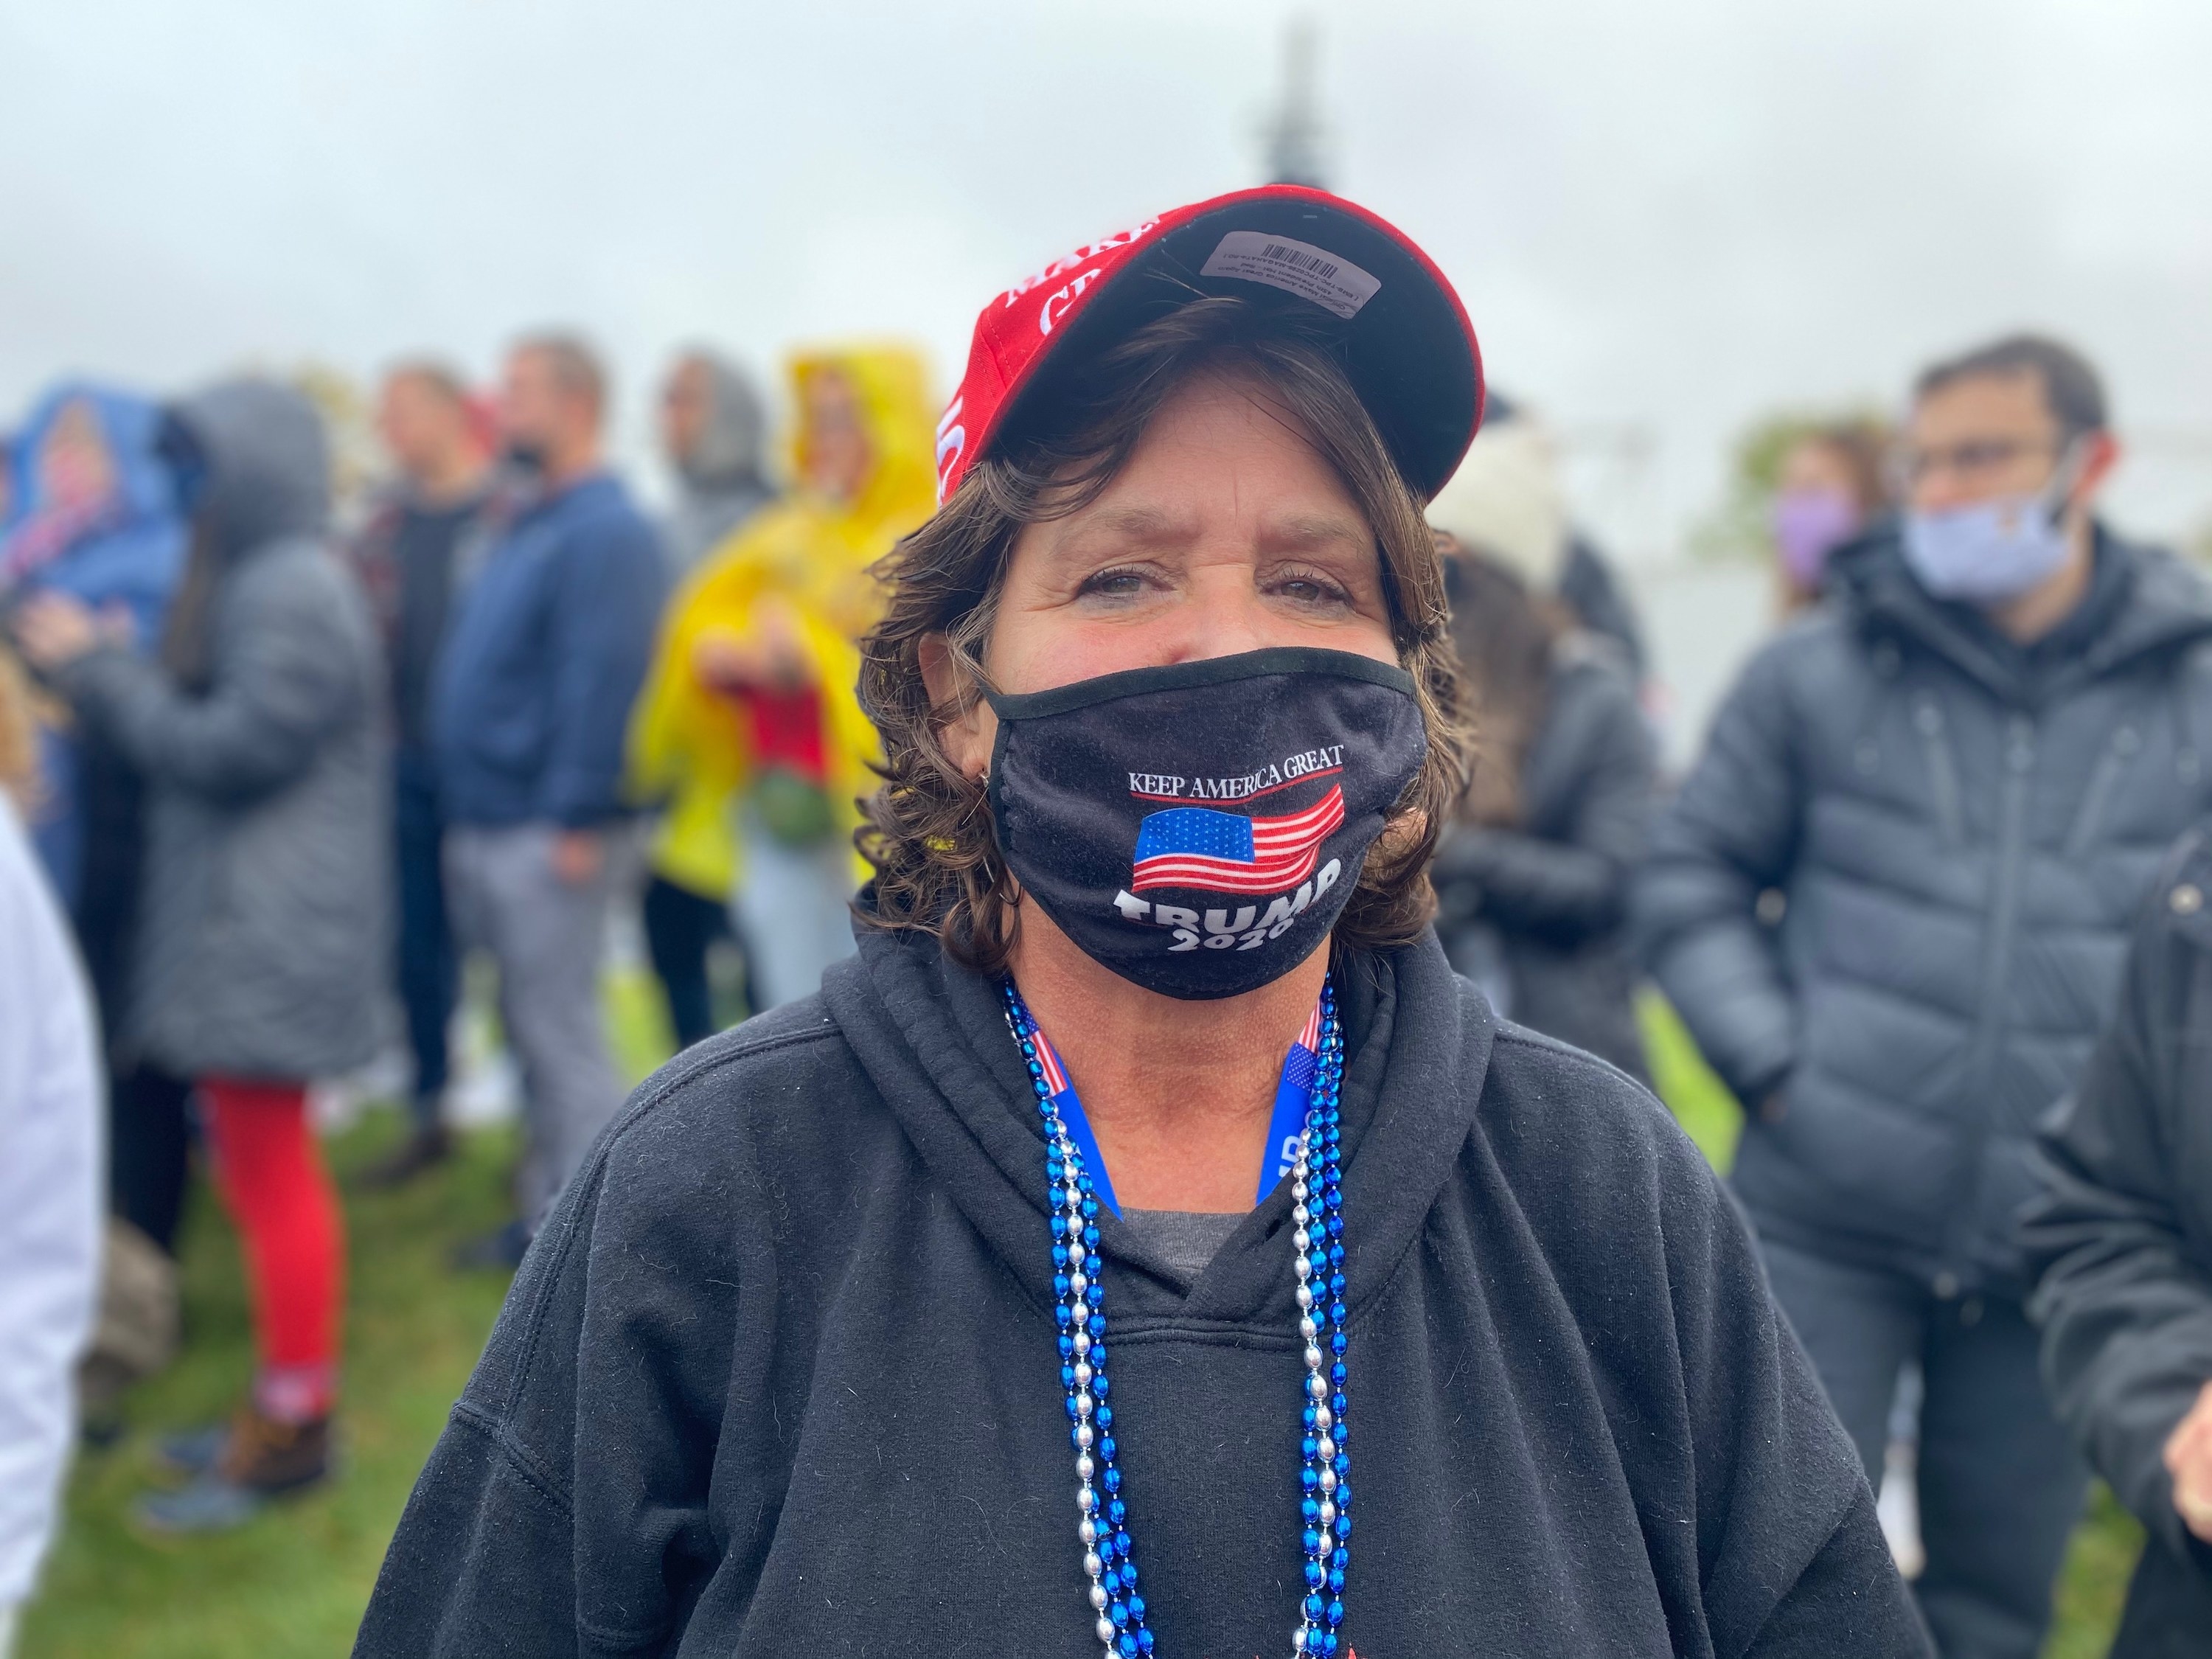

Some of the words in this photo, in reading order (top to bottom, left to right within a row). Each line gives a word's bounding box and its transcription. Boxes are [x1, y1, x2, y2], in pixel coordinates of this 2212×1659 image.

[1242, 268, 1264, 276] Great
[1278, 270, 1315, 287] President
[1266, 274, 1298, 286] America
[1298, 284, 1320, 296] Make
[1316, 285, 1332, 295] 45th
[1128, 772, 1186, 795] KEEP
[1190, 765, 1282, 799] AMERICA
[1284, 744, 1345, 779] GREAT
[1113, 858, 1342, 935] TRUMP
[1167, 917, 1295, 952] 2020
